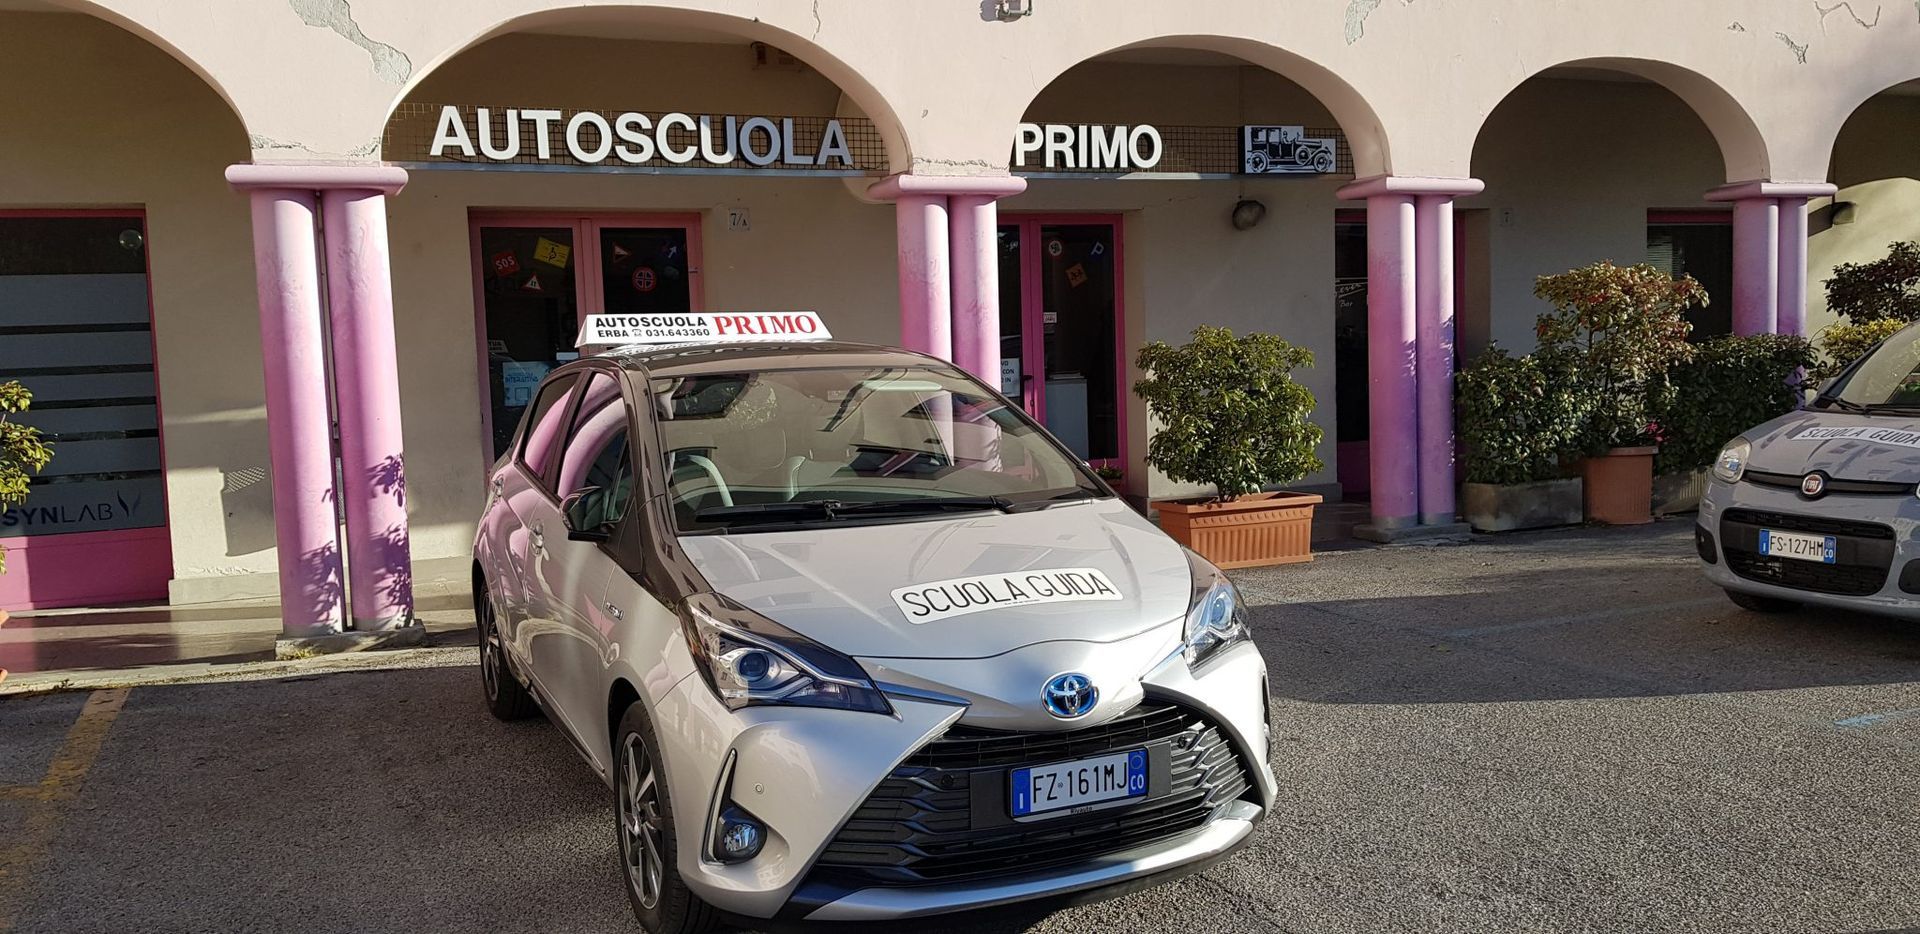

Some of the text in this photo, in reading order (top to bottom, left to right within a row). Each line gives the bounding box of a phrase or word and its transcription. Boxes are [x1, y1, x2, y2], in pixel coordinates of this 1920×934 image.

[430, 106, 853, 166] AUTOSCUOLA
[1014, 123, 1162, 168] PRIMO
[495, 255, 515, 270] SOS
[595, 314, 817, 336] AUTOSCUOLA PRIMO
[598, 328, 710, 338] ERBA 031.643360
[1802, 428, 1920, 444] SCUOLA GUIDA
[2, 502, 113, 526] SYNLAB
[902, 572, 1116, 617] SCUOLA GUIDA
[1130, 774, 1145, 791] CO
